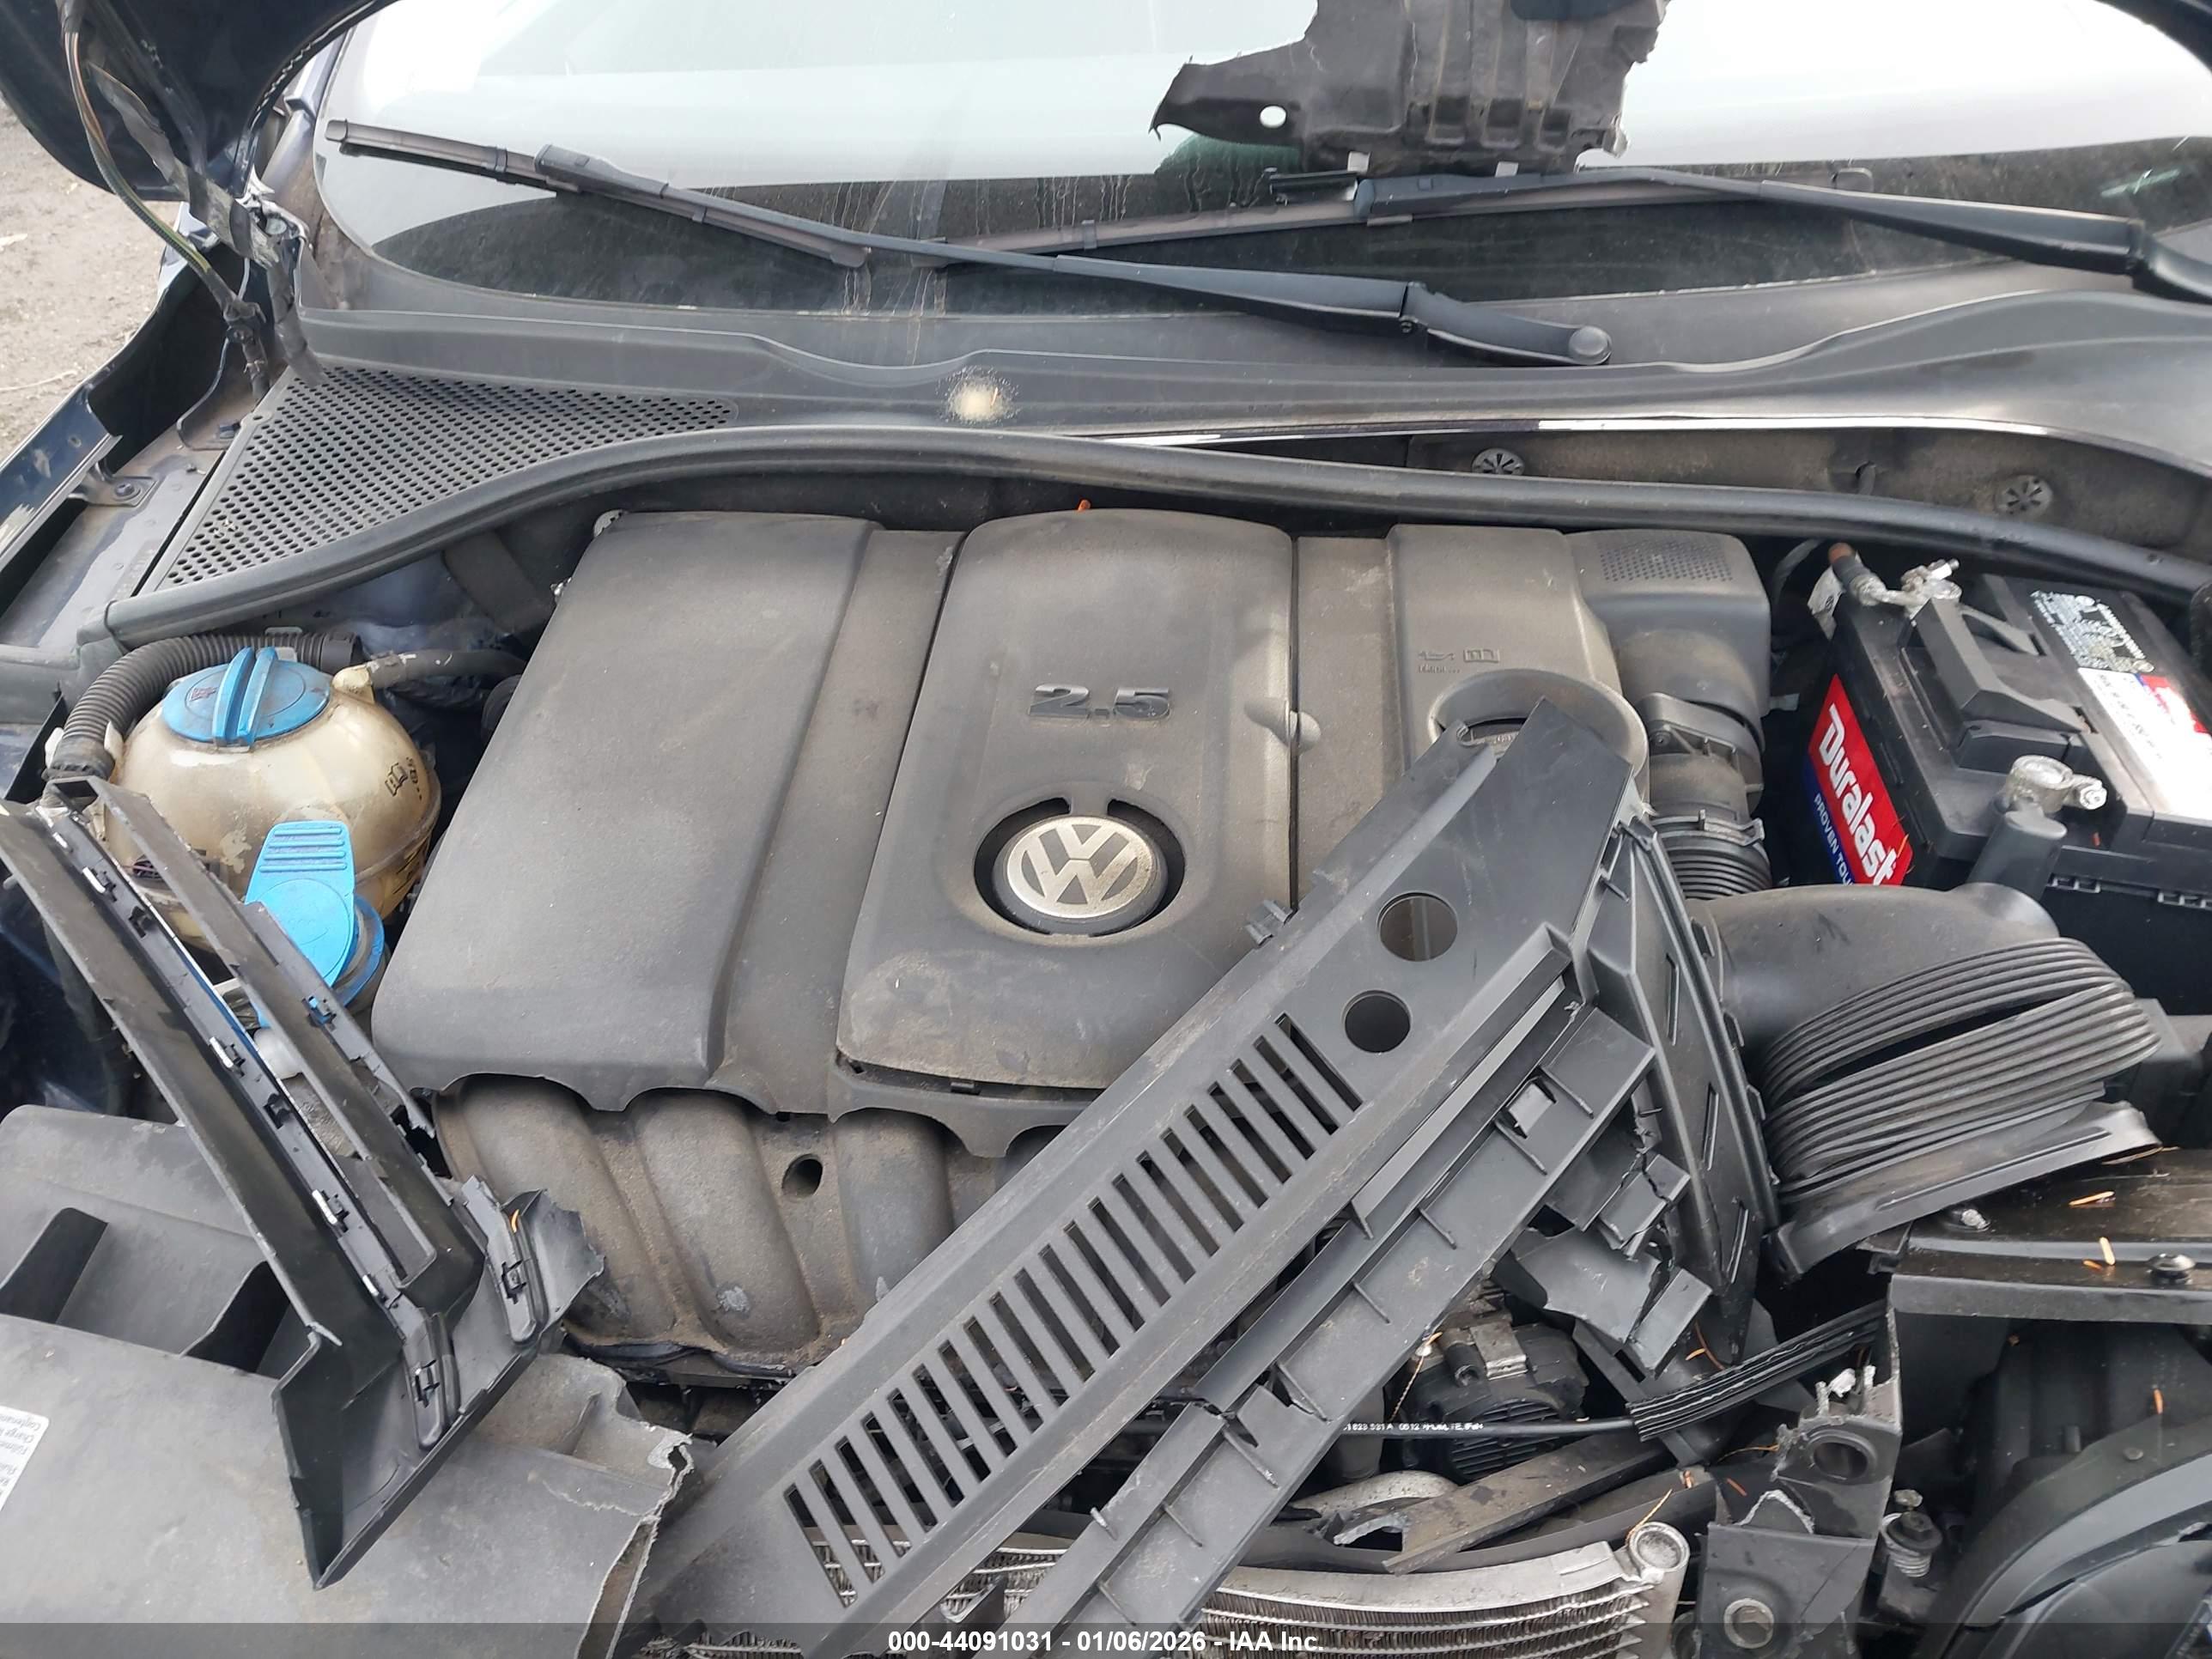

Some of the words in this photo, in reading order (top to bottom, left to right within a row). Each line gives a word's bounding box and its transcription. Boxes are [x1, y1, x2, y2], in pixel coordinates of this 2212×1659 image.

[1030, 684, 1170, 720] 2.5
[1814, 793, 1838, 853] PROVEN
[1837, 852, 1855, 886] TOU
[1819, 703, 1897, 886] Duralast
[1008, 817, 1153, 918] VW
